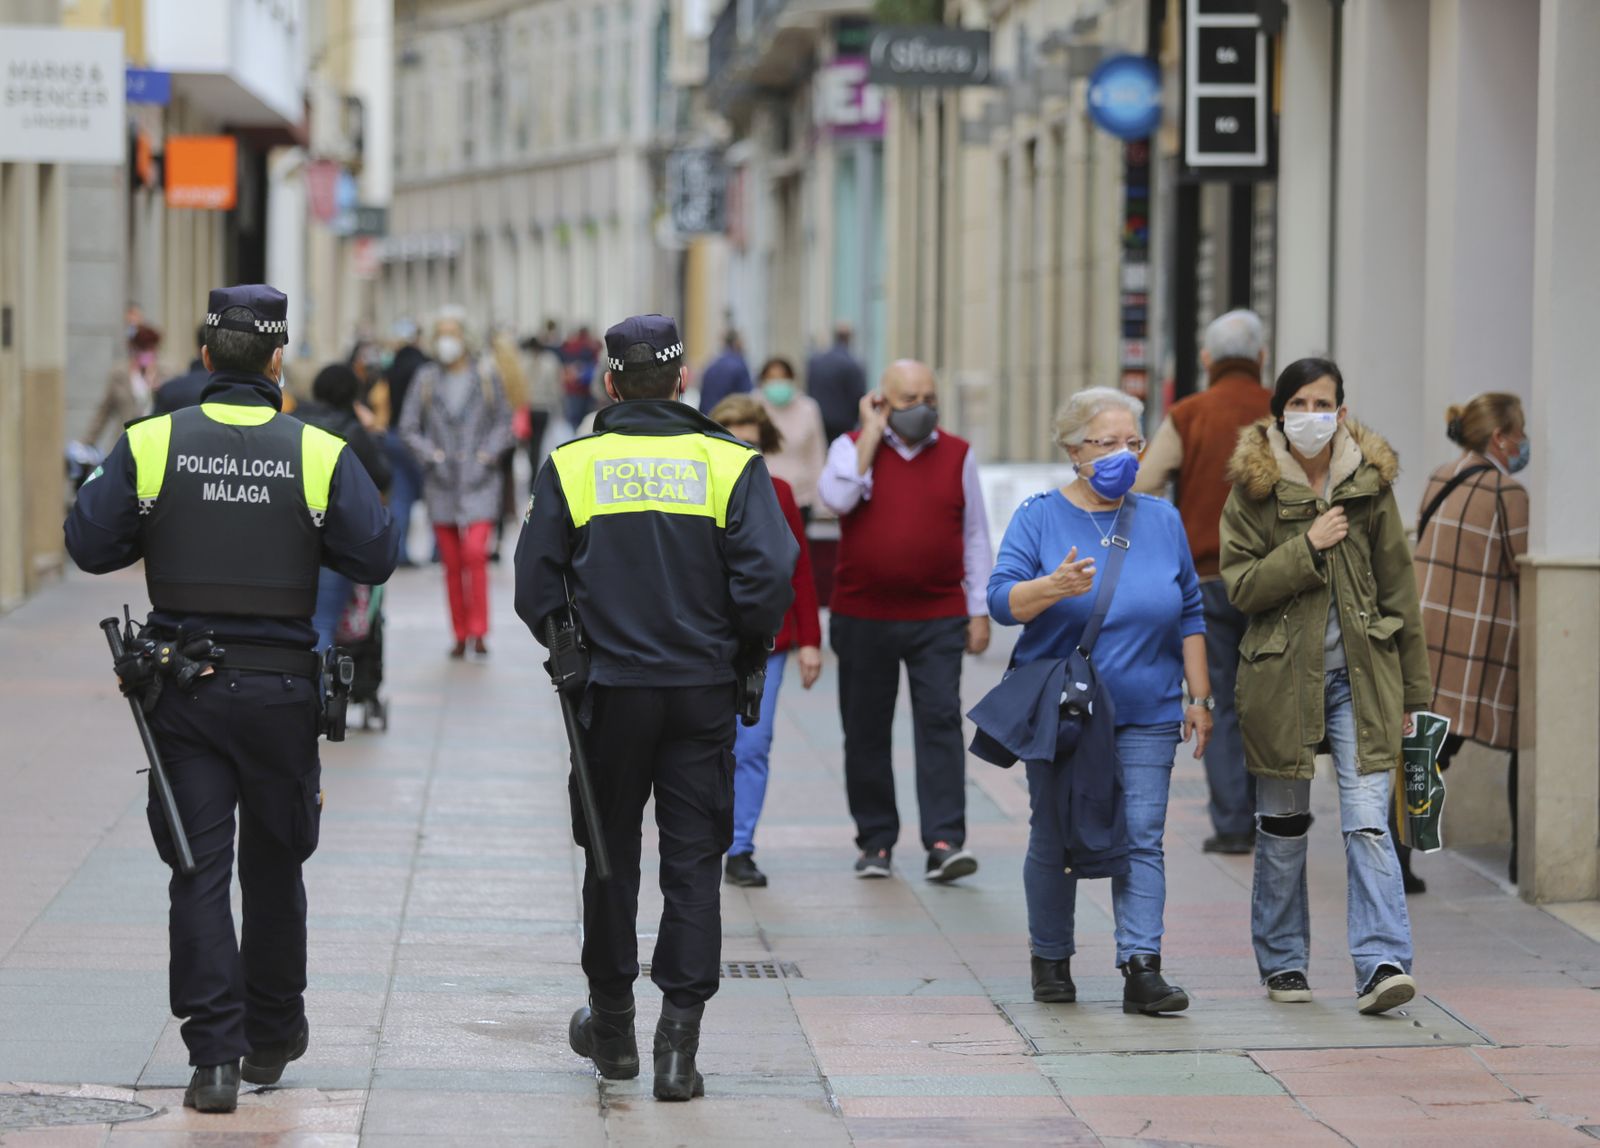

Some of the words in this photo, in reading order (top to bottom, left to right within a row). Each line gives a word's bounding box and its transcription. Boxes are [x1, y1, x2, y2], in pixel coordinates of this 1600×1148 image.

[7, 62, 85, 83] MARKS
[4, 86, 109, 108] SPENCER
[177, 454, 239, 475] POLICÍA
[242, 459, 295, 478] LOCAL
[602, 462, 699, 481] POLICIA
[203, 480, 270, 503] MÁLAGA
[612, 481, 689, 500] LOCAL
[1404, 761, 1424, 772] Casa
[1412, 772, 1425, 782] del
